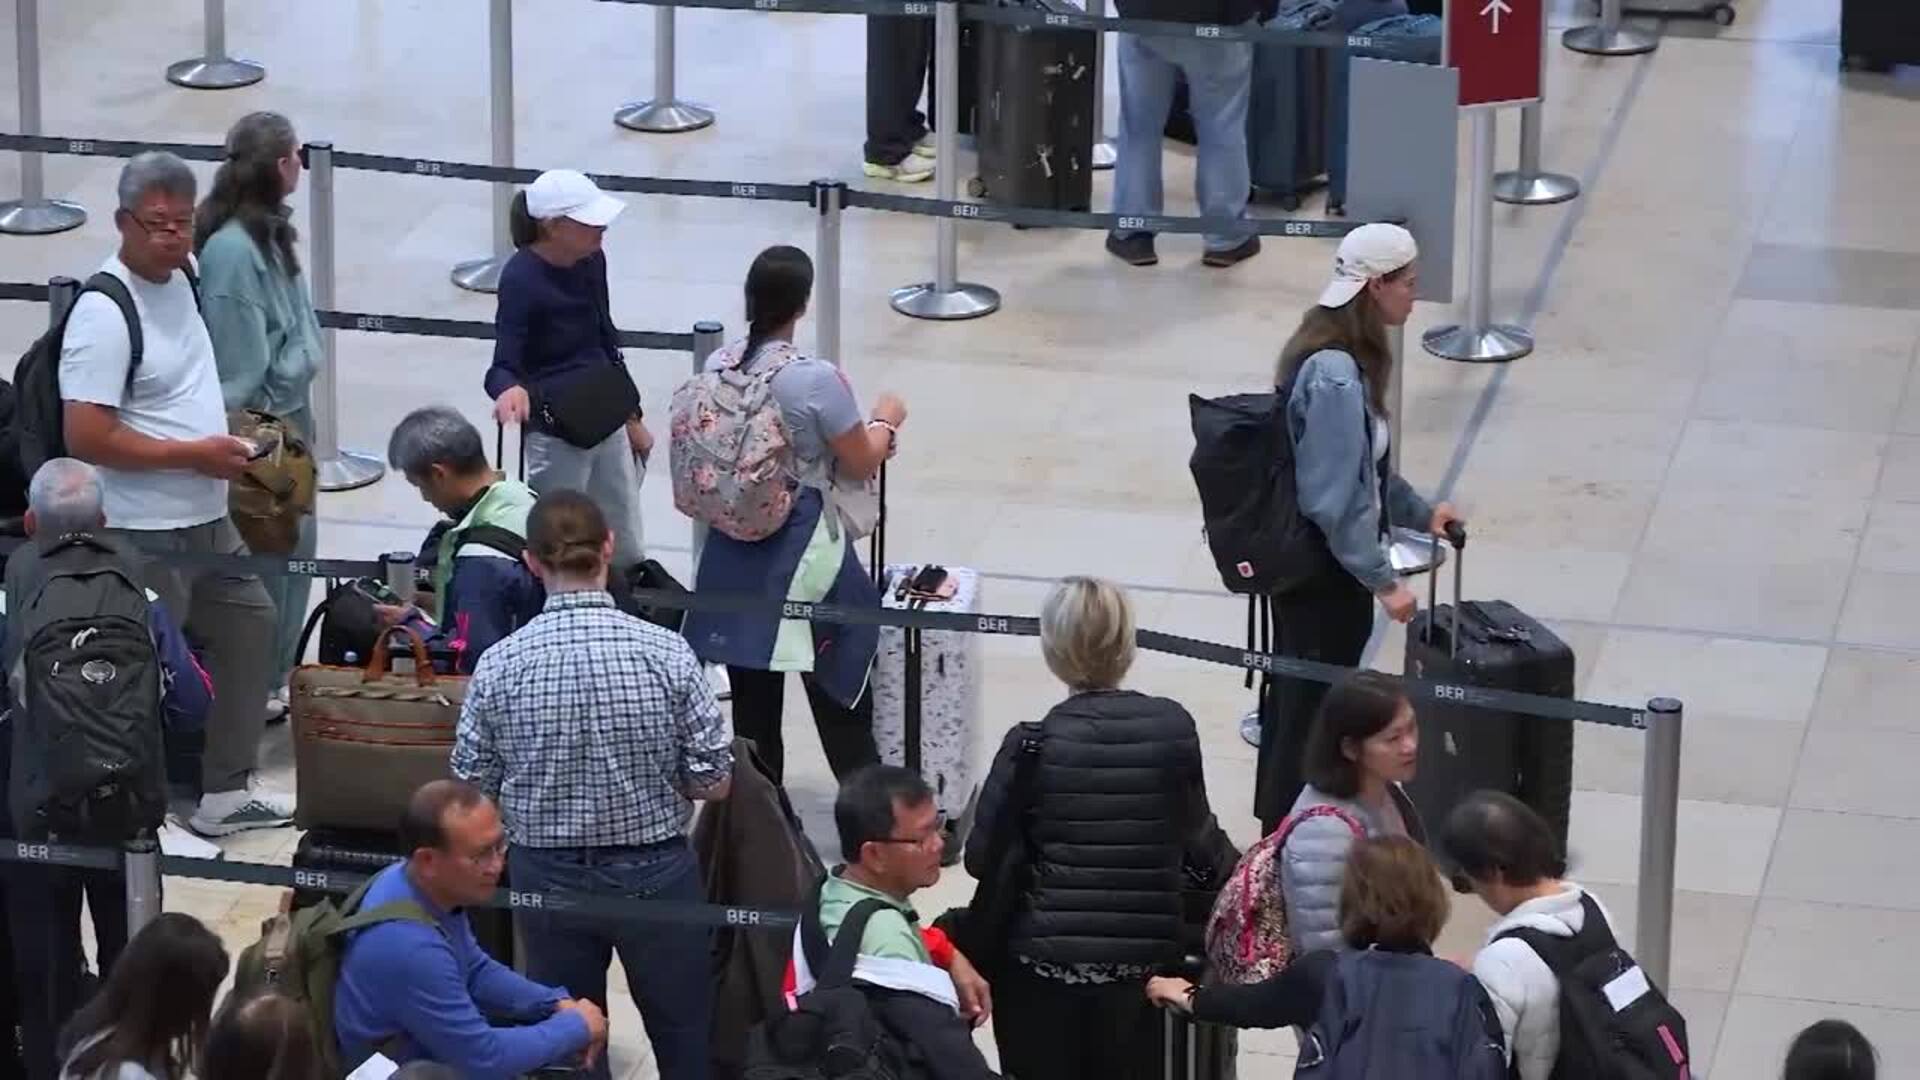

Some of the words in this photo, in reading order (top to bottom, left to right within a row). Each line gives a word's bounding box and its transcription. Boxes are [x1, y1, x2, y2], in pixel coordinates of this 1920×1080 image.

[1196, 26, 1219, 37] BER
[732, 185, 756, 196] BER
[953, 205, 979, 217] BER
[1119, 217, 1144, 229] BER
[1286, 223, 1311, 235] BER
[358, 317, 383, 328] BER
[288, 561, 317, 574] BER
[783, 603, 813, 617] BER
[978, 617, 1008, 632] BER
[1243, 653, 1272, 670] BER
[1435, 685, 1465, 700] BER
[18, 843, 49, 860] BER
[295, 871, 328, 888] BER
[510, 891, 543, 908] BER
[727, 909, 760, 925] BER
